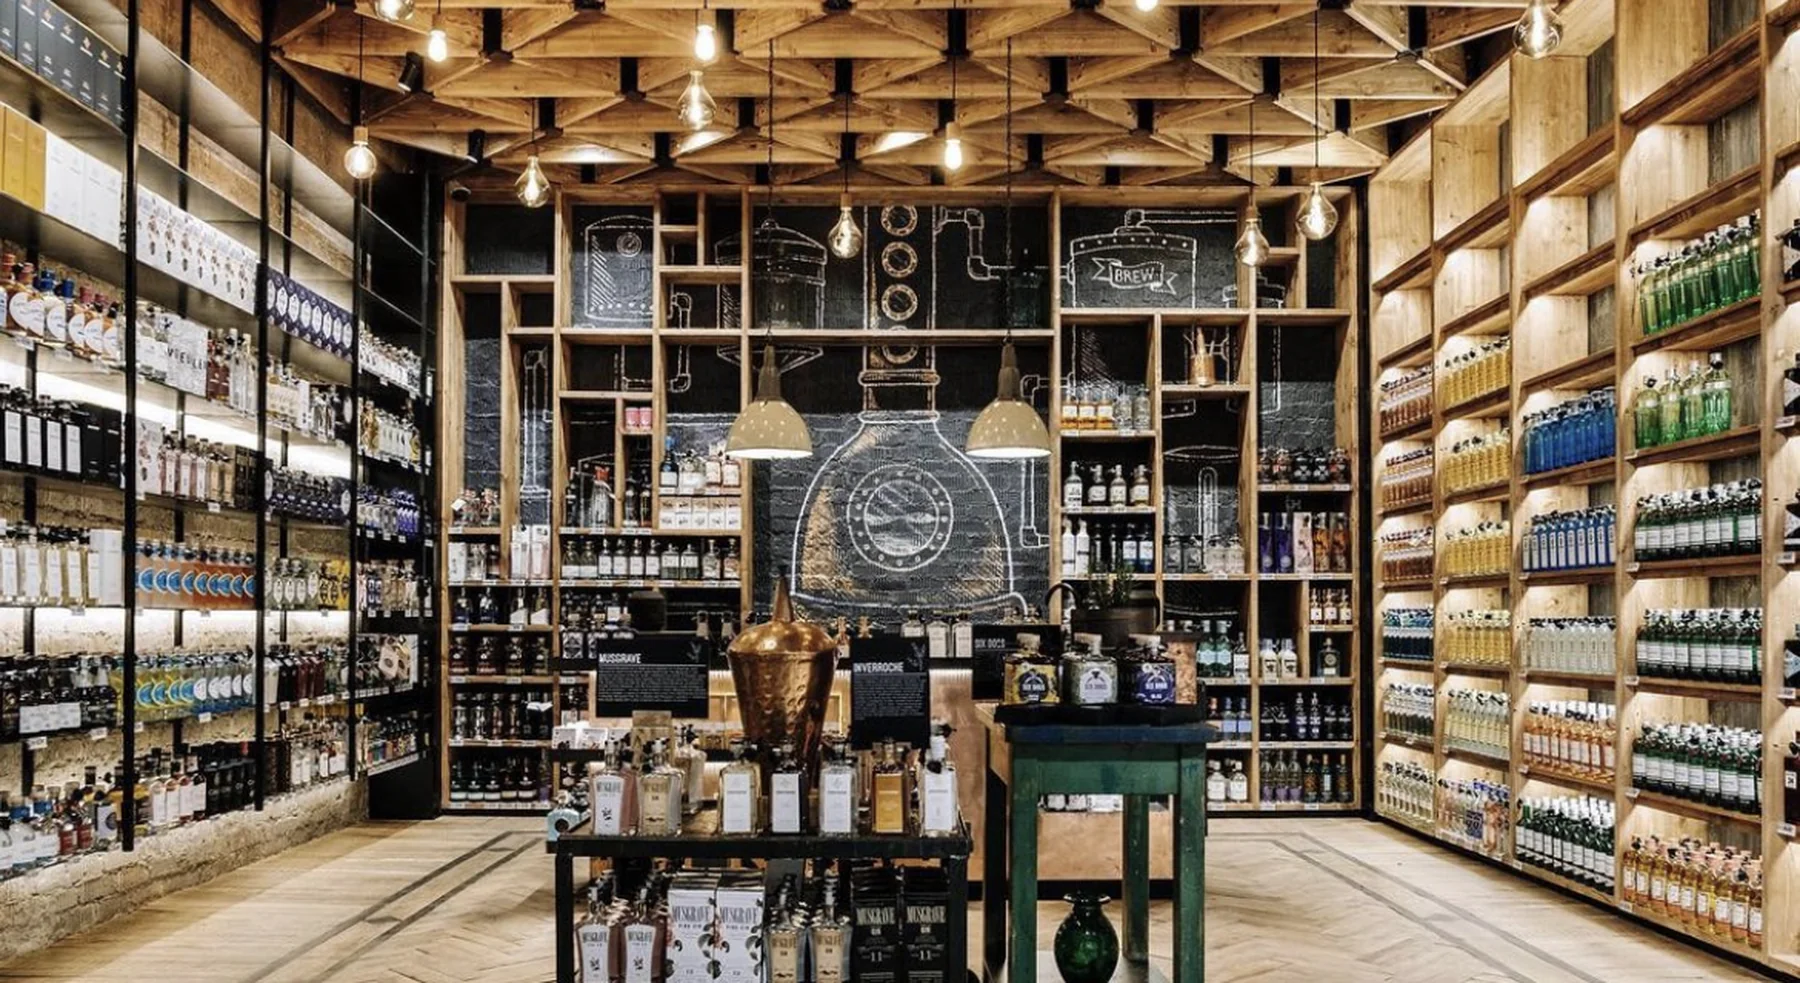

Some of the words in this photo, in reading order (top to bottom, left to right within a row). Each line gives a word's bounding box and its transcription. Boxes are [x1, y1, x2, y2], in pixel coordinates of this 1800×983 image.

[1115, 267, 1155, 284] BREW
[599, 653, 642, 664] MUSGRAVE
[853, 661, 904, 673] INVERROCHE
[672, 906, 710, 923] MUSGRAVE
[720, 906, 759, 924] MUSGRAVE
[856, 907, 896, 925] MUSGRAVE
[906, 906, 947, 924] MUSGRAVE
